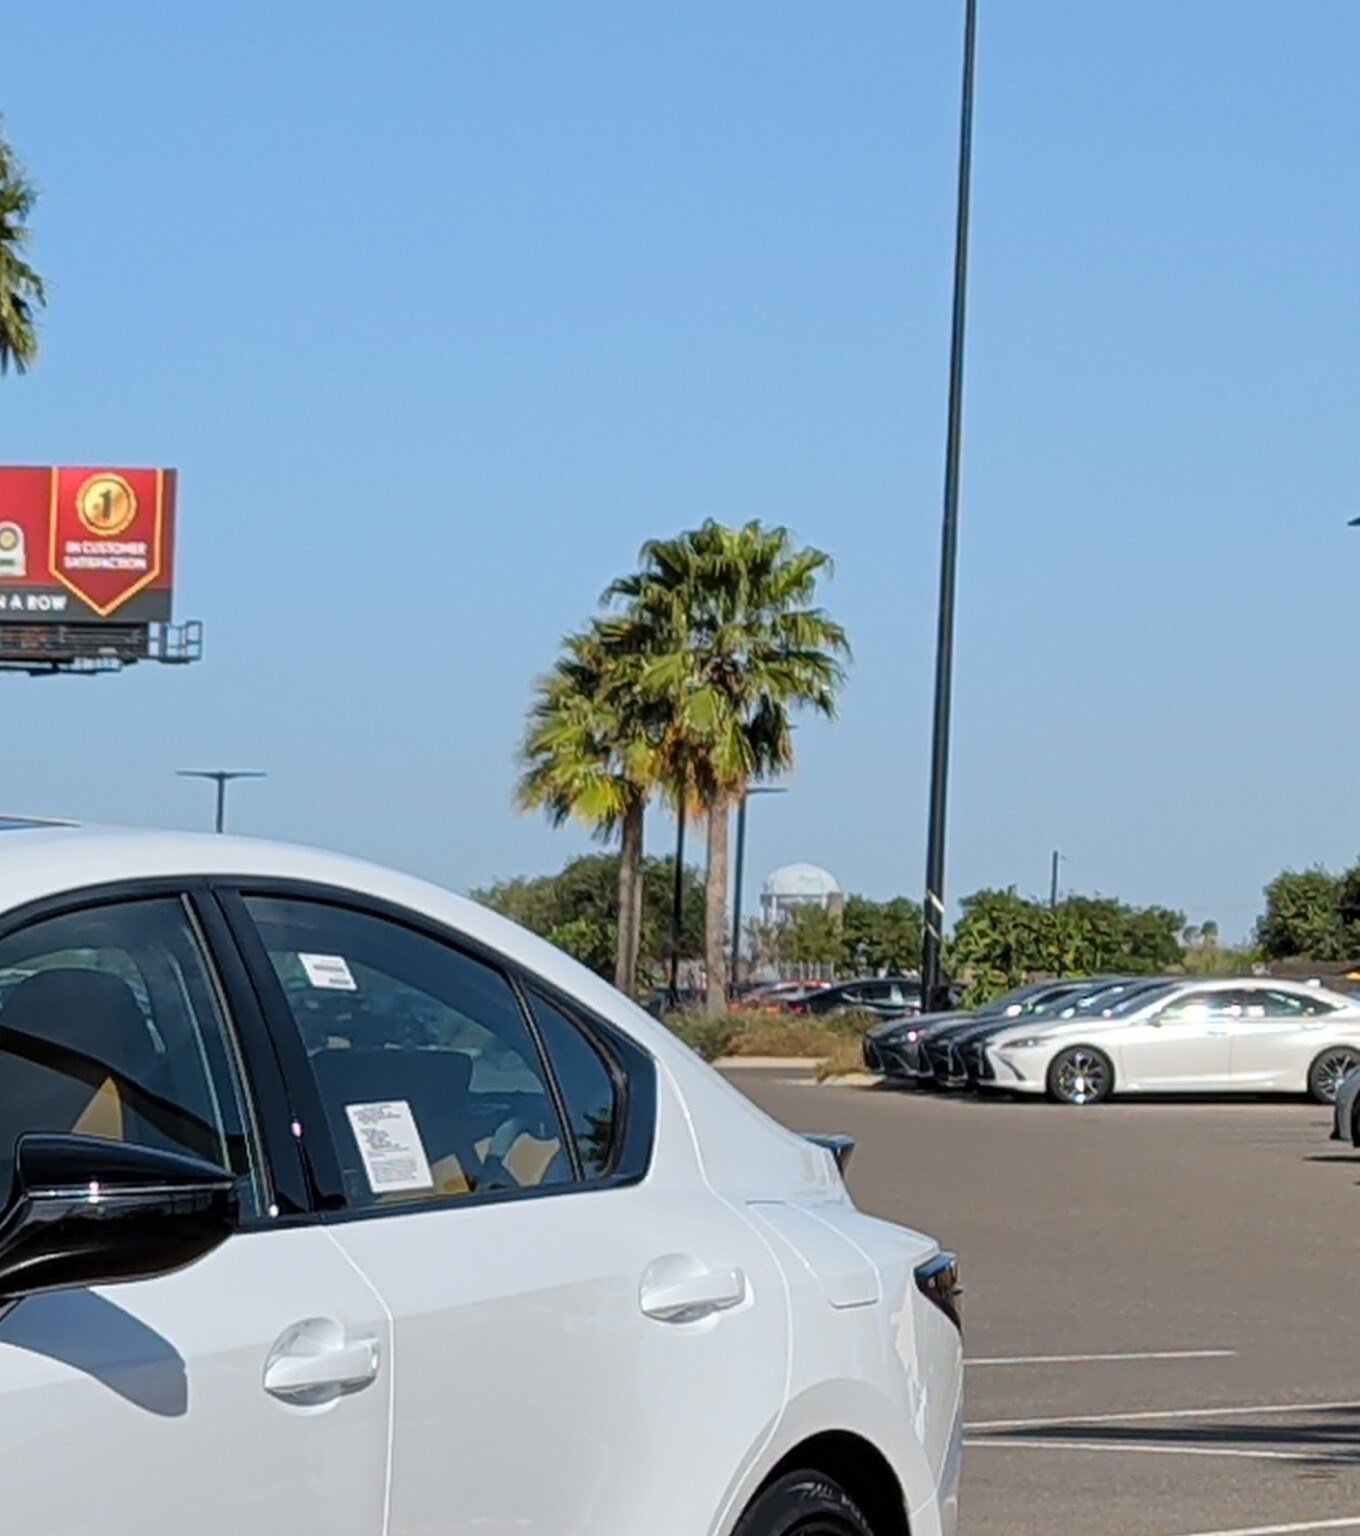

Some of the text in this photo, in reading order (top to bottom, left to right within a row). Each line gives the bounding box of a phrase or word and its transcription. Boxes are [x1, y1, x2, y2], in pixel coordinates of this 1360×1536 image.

[82, 541, 148, 556] CUSTOMER
[63, 556, 148, 570] SATISFACTION
[8, 595, 24, 610] A
[29, 594, 68, 611] ROW
